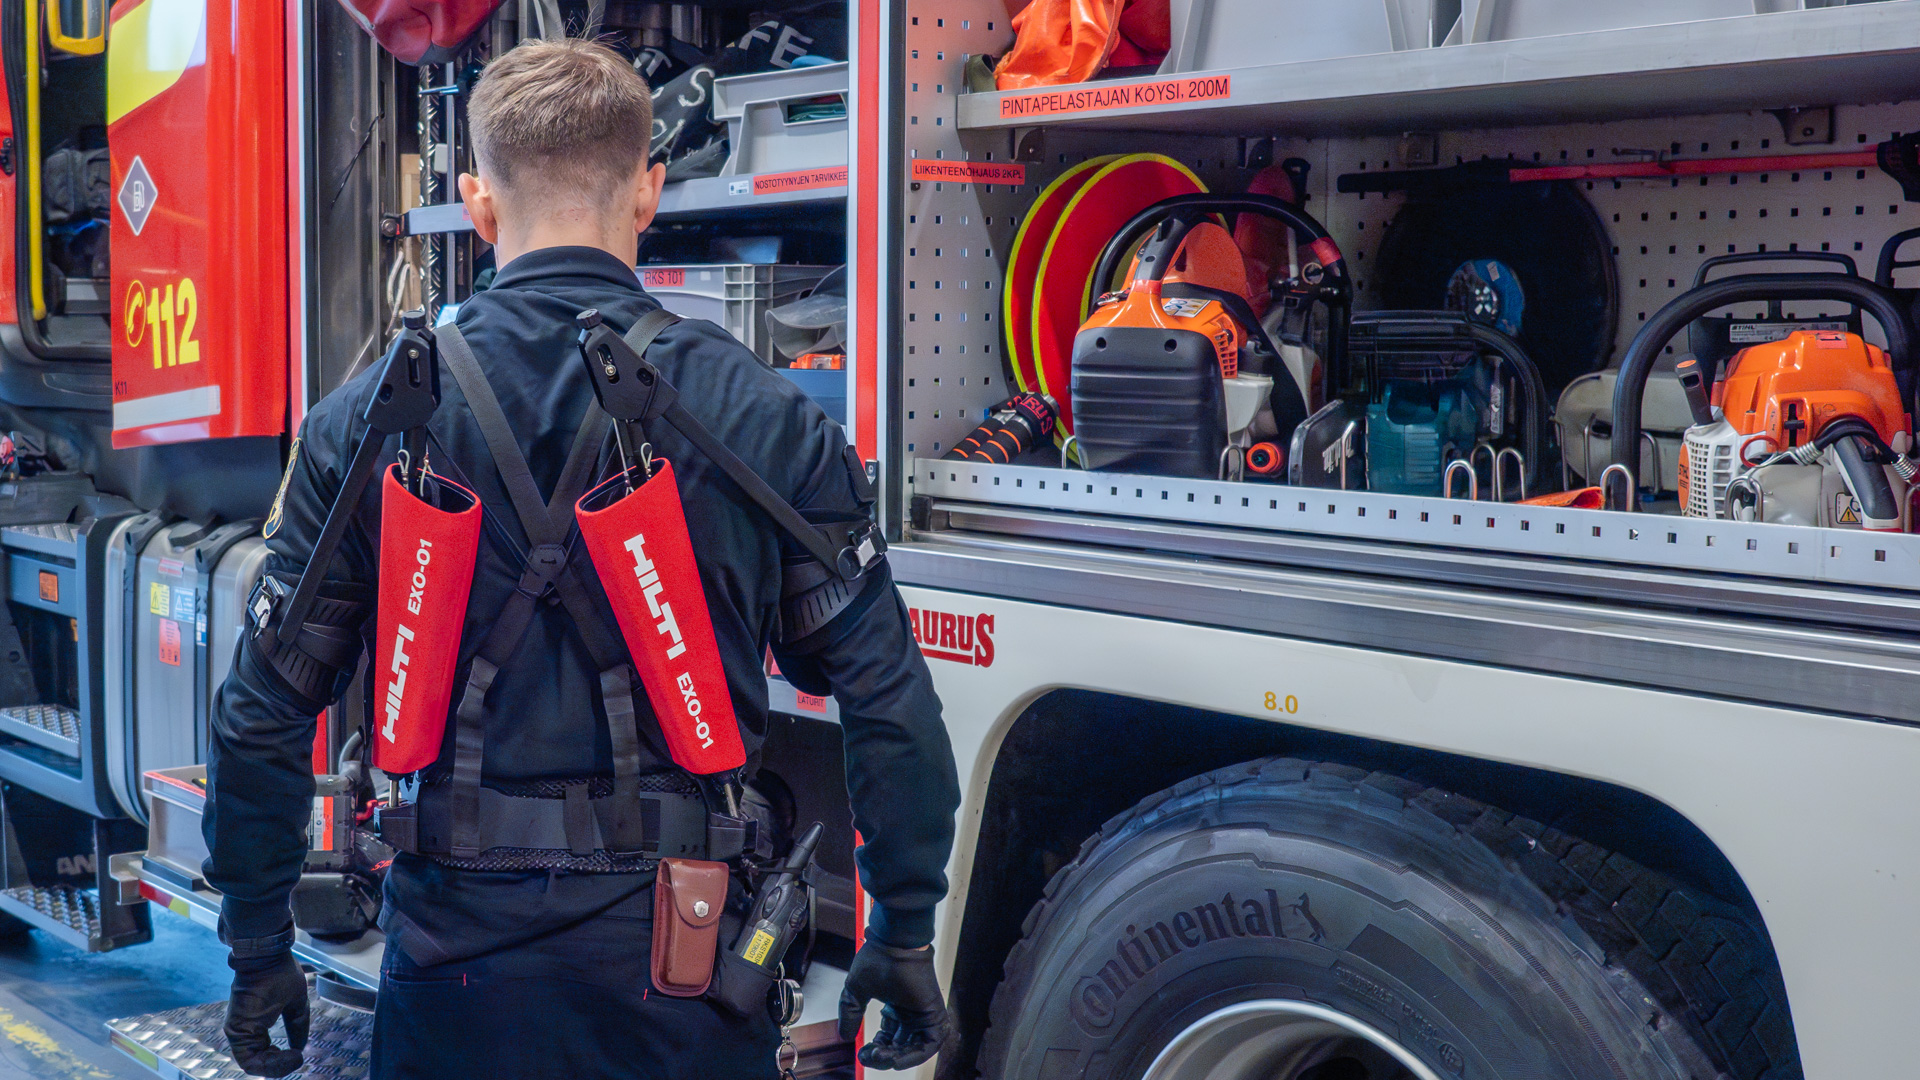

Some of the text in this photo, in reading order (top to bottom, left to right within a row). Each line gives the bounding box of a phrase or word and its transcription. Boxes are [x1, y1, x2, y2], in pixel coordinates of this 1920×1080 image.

[1002, 79, 1228, 115] PINTAPELASTAJAN KÖYSI, 200M
[755, 175, 810, 190] NOSTOTYYNYJEN
[915, 165, 1024, 179] LIIKENTEENOHJAUS 2KPL
[645, 271, 682, 285] RKS 101
[147, 278, 200, 369] 112
[115, 381, 128, 395] K11
[382, 538, 433, 744] HILTI EXO-01
[624, 533, 714, 749] HILTI EXO-01
[797, 695, 825, 708] LATURIT
[1263, 691, 1299, 715] 8.0
[1070, 888, 1289, 1039] Continental
